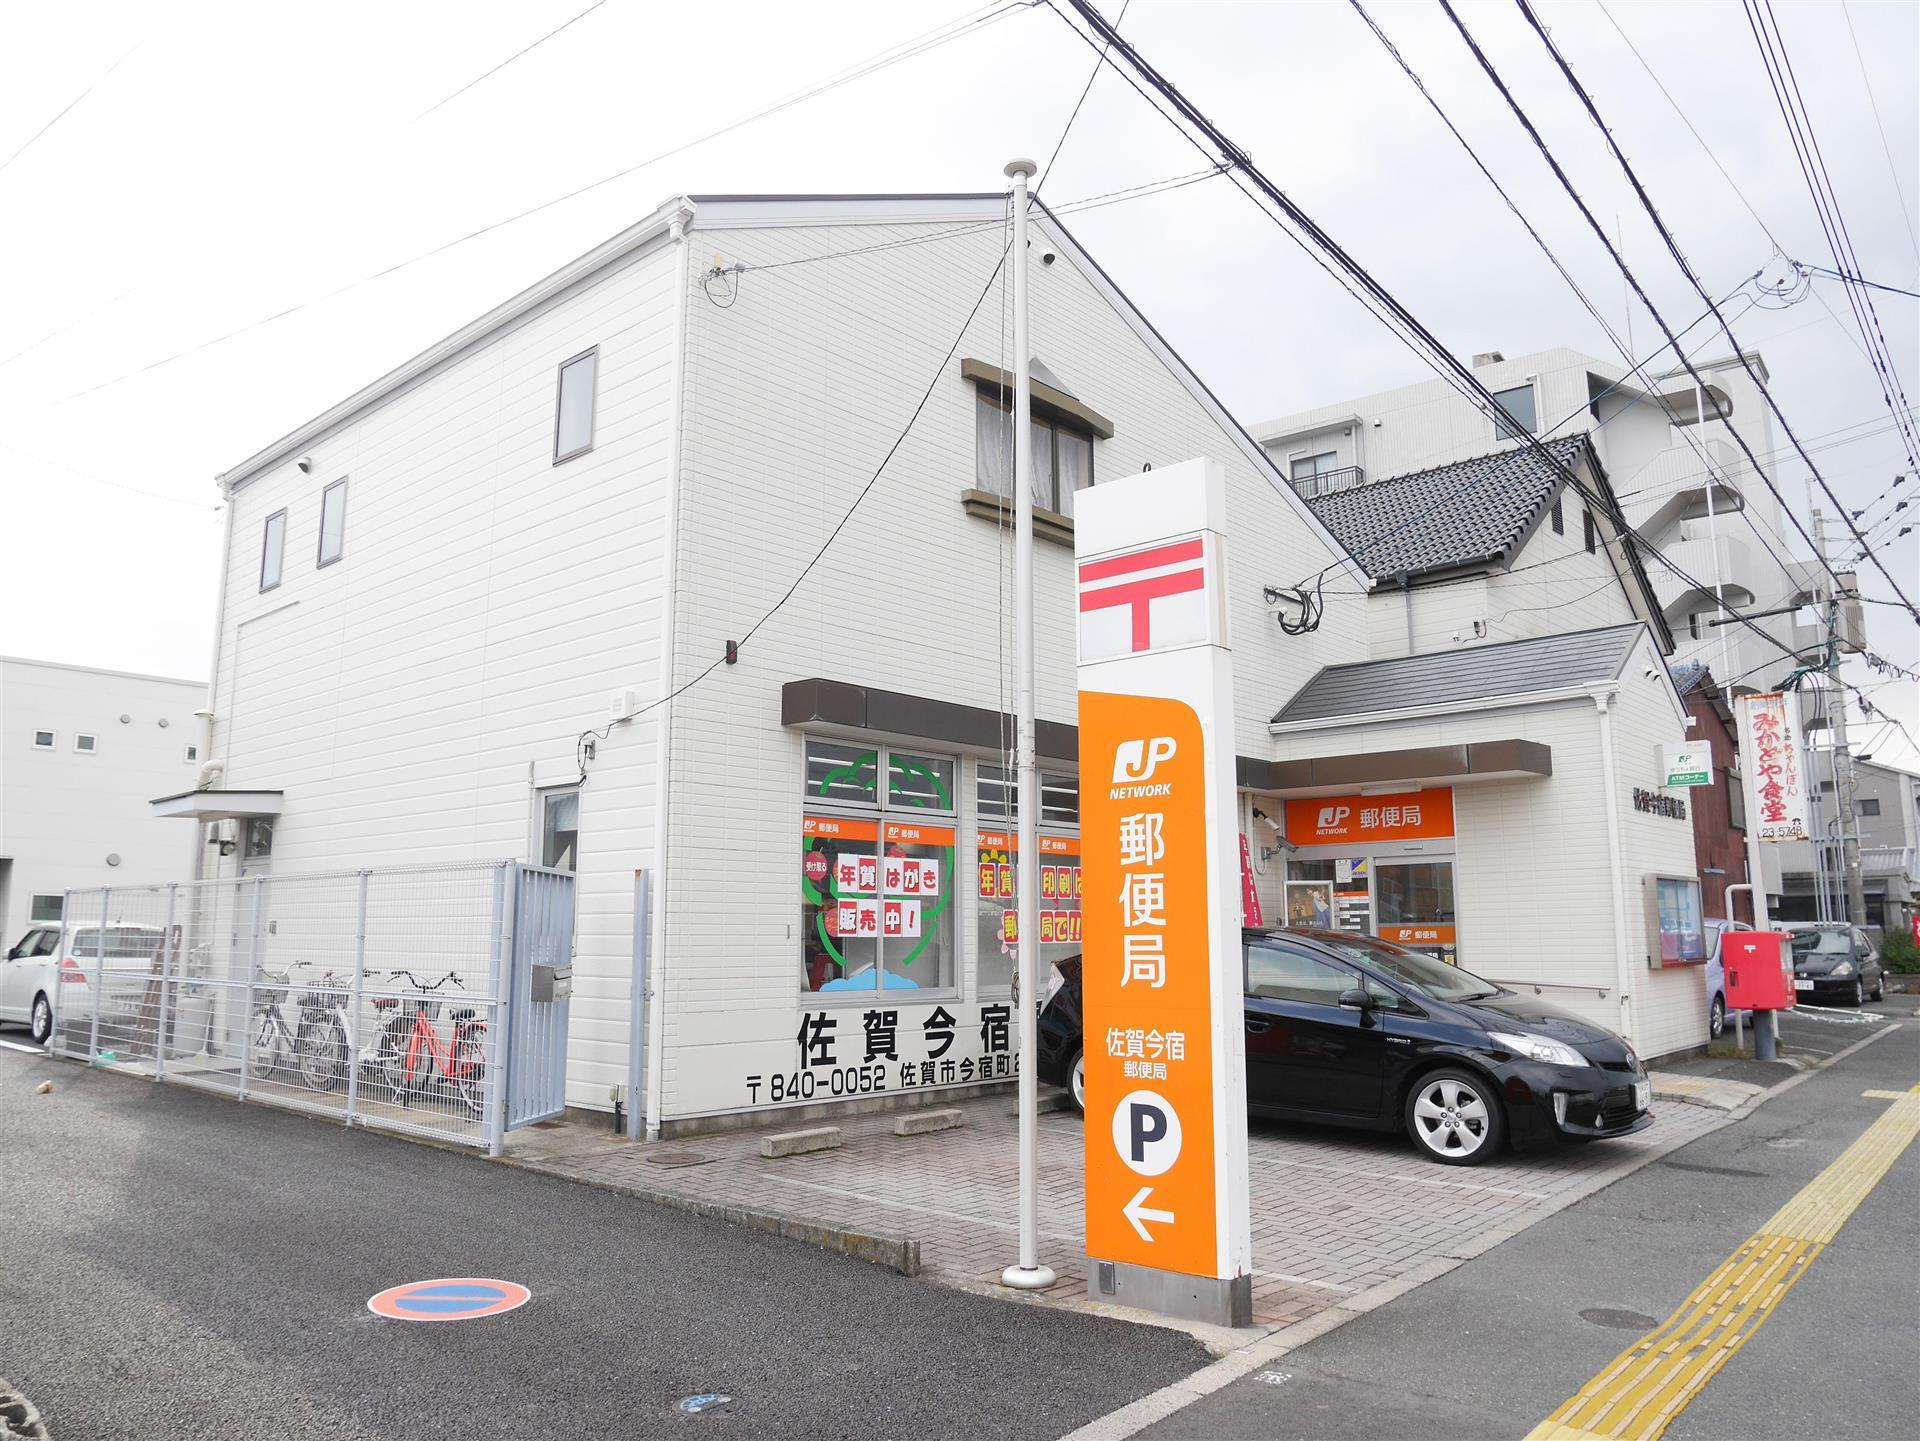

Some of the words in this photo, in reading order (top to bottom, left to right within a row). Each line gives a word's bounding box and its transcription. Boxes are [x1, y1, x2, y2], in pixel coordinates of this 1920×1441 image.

[1112, 737, 1177, 783] JP
[1753, 713, 1787, 823] みかどや食堂
[1109, 783, 1172, 800] NETWORK
[818, 822, 839, 834] 郵便局
[1317, 806, 1350, 828] JP
[1359, 805, 1422, 829] 郵便局
[1315, 828, 1348, 836] NETWORK
[805, 861, 828, 872] 受け取る
[839, 864, 937, 889] 年賀はがき
[1119, 812, 1168, 989] 郵便局
[1106, 1028, 1185, 1061] 佐賀今宿
[1123, 1061, 1168, 1080] 郵便局
[1129, 1102, 1168, 1163] P
